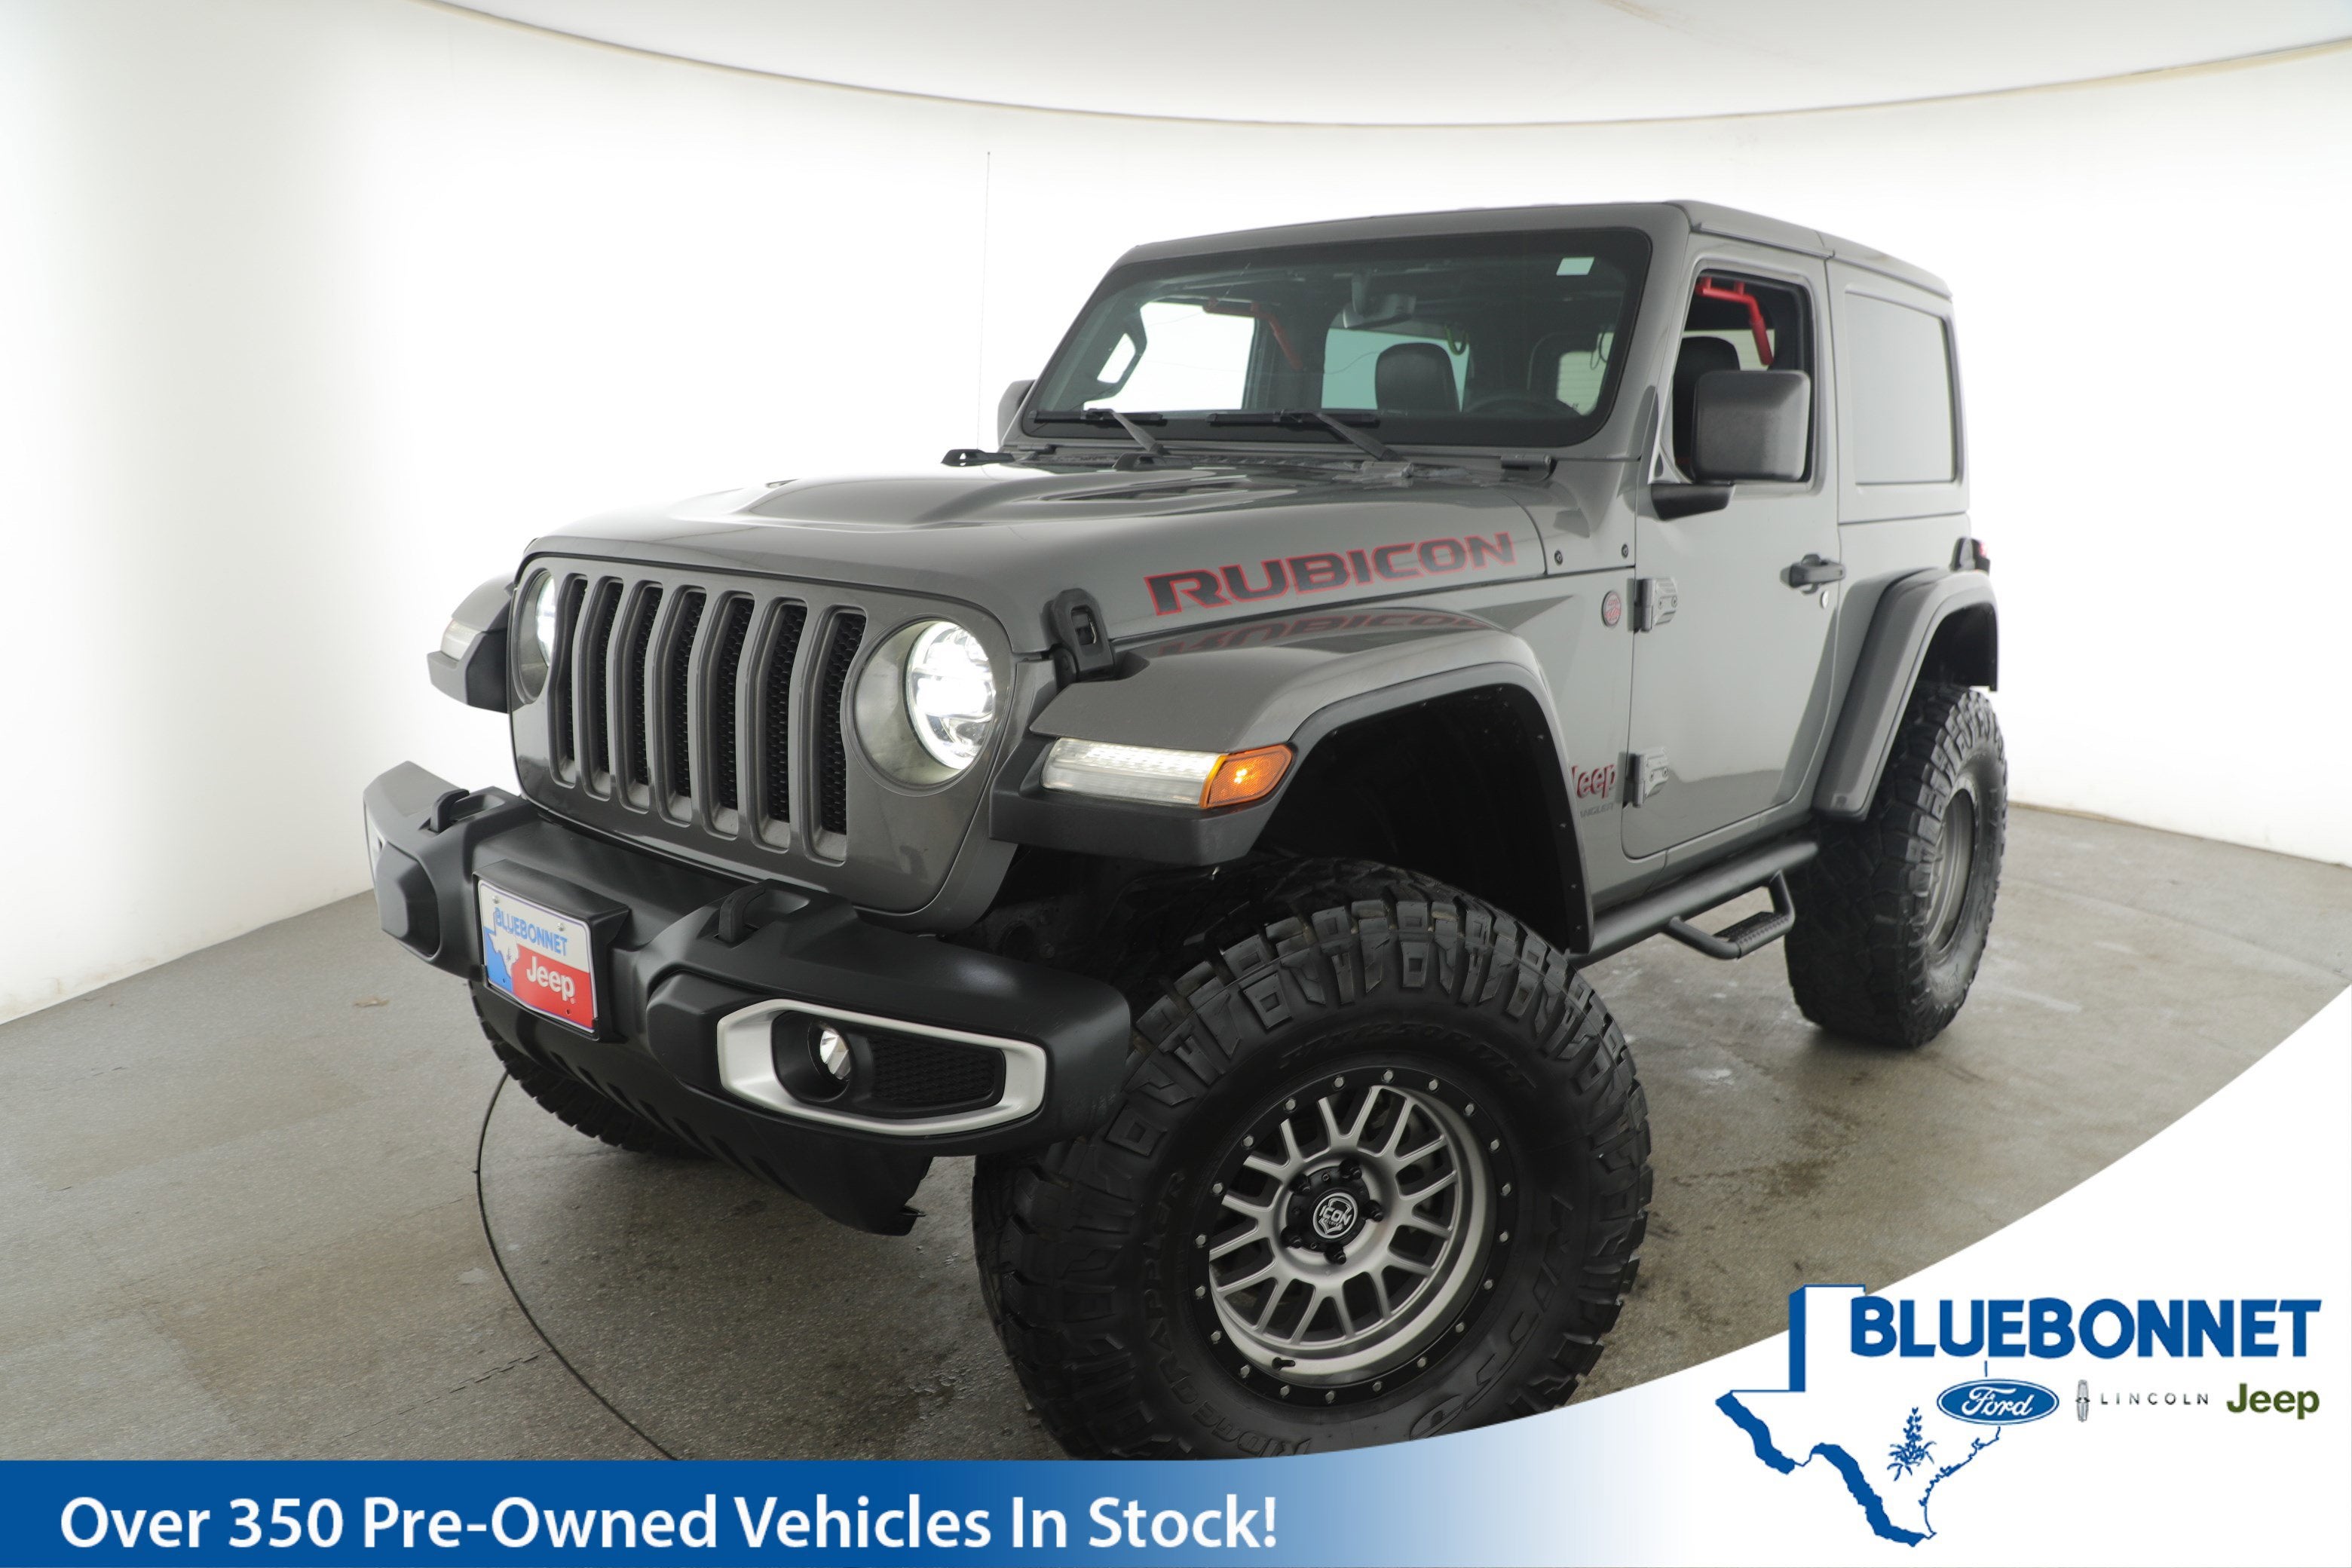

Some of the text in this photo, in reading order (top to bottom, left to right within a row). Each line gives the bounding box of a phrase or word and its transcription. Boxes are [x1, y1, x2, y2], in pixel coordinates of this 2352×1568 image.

[1144, 532, 1517, 617] RUBICON
[493, 907, 568, 957] BLUEBONNET
[526, 955, 576, 1001] Jeep
[1318, 1205, 1353, 1226] ICON
